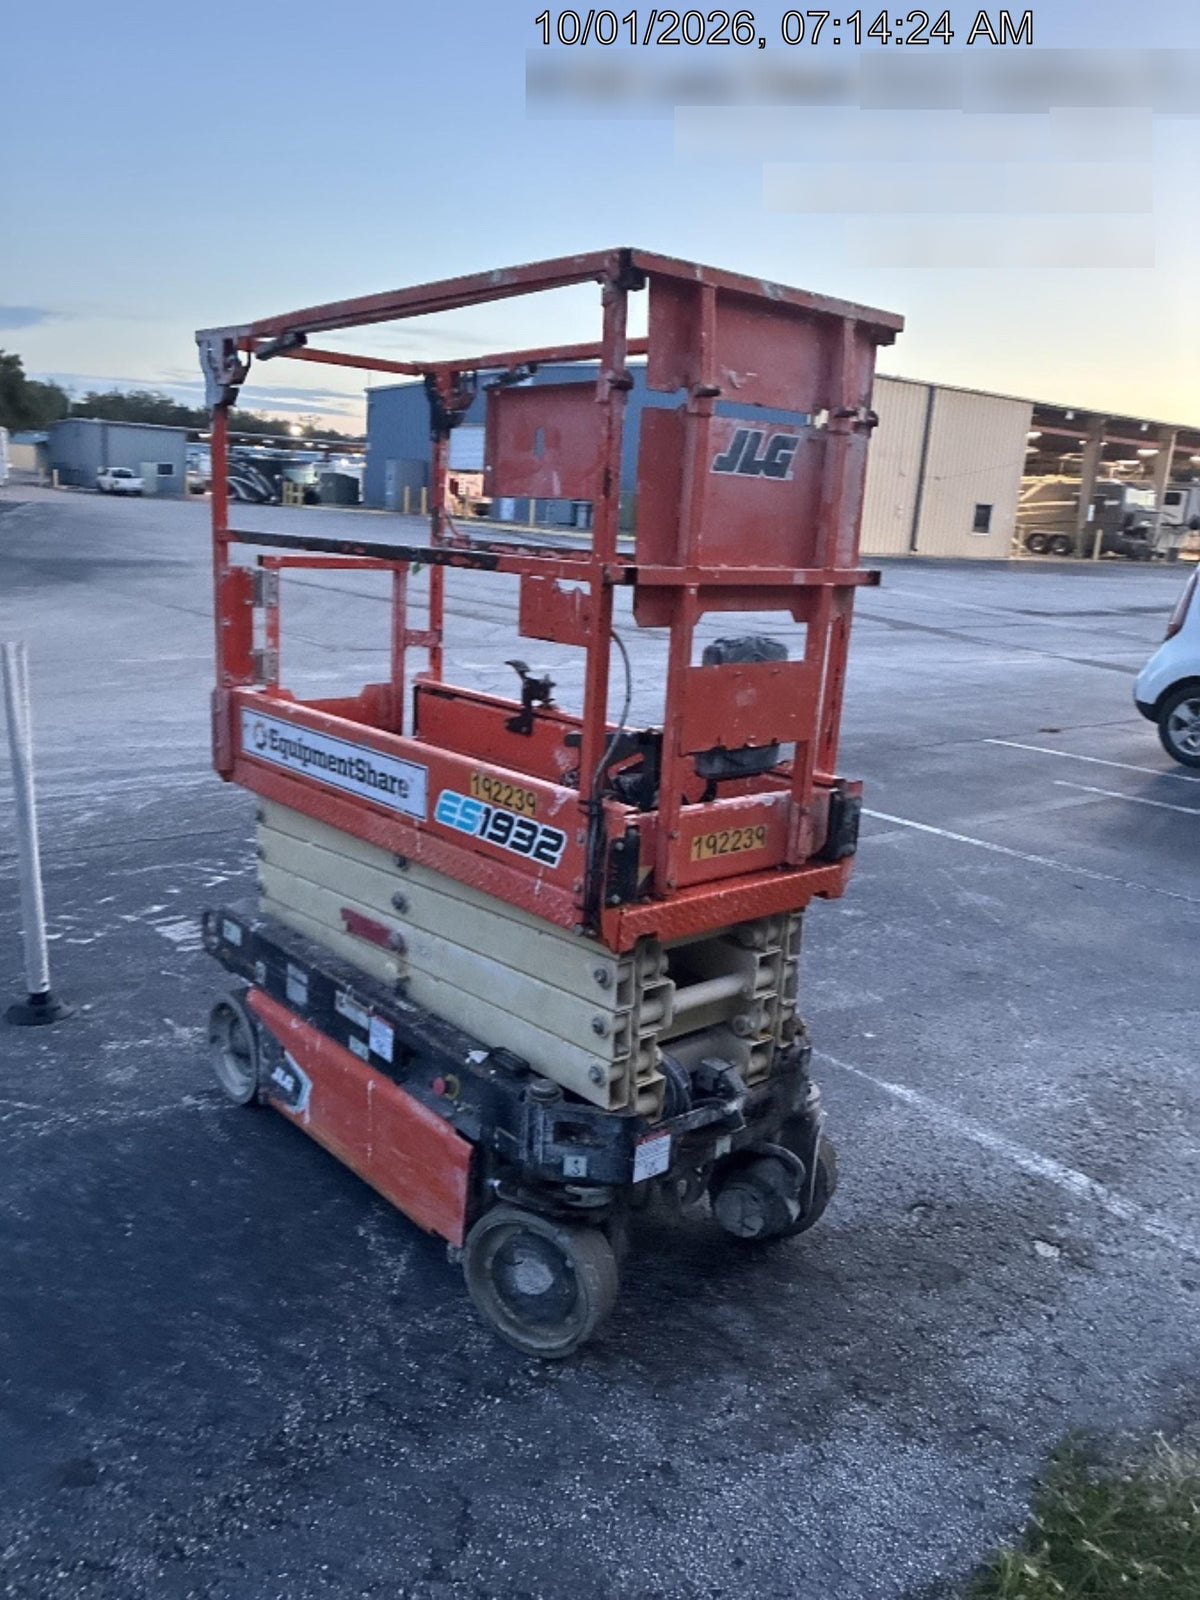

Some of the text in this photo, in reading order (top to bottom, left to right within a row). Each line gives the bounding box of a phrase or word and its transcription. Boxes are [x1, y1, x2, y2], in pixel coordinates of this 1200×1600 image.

[710, 427, 801, 481] JLG
[268, 728, 409, 799] EquipmentShare
[471, 773, 537, 813] 192239
[435, 790, 566, 868] ES1932
[693, 825, 767, 860] 192239
